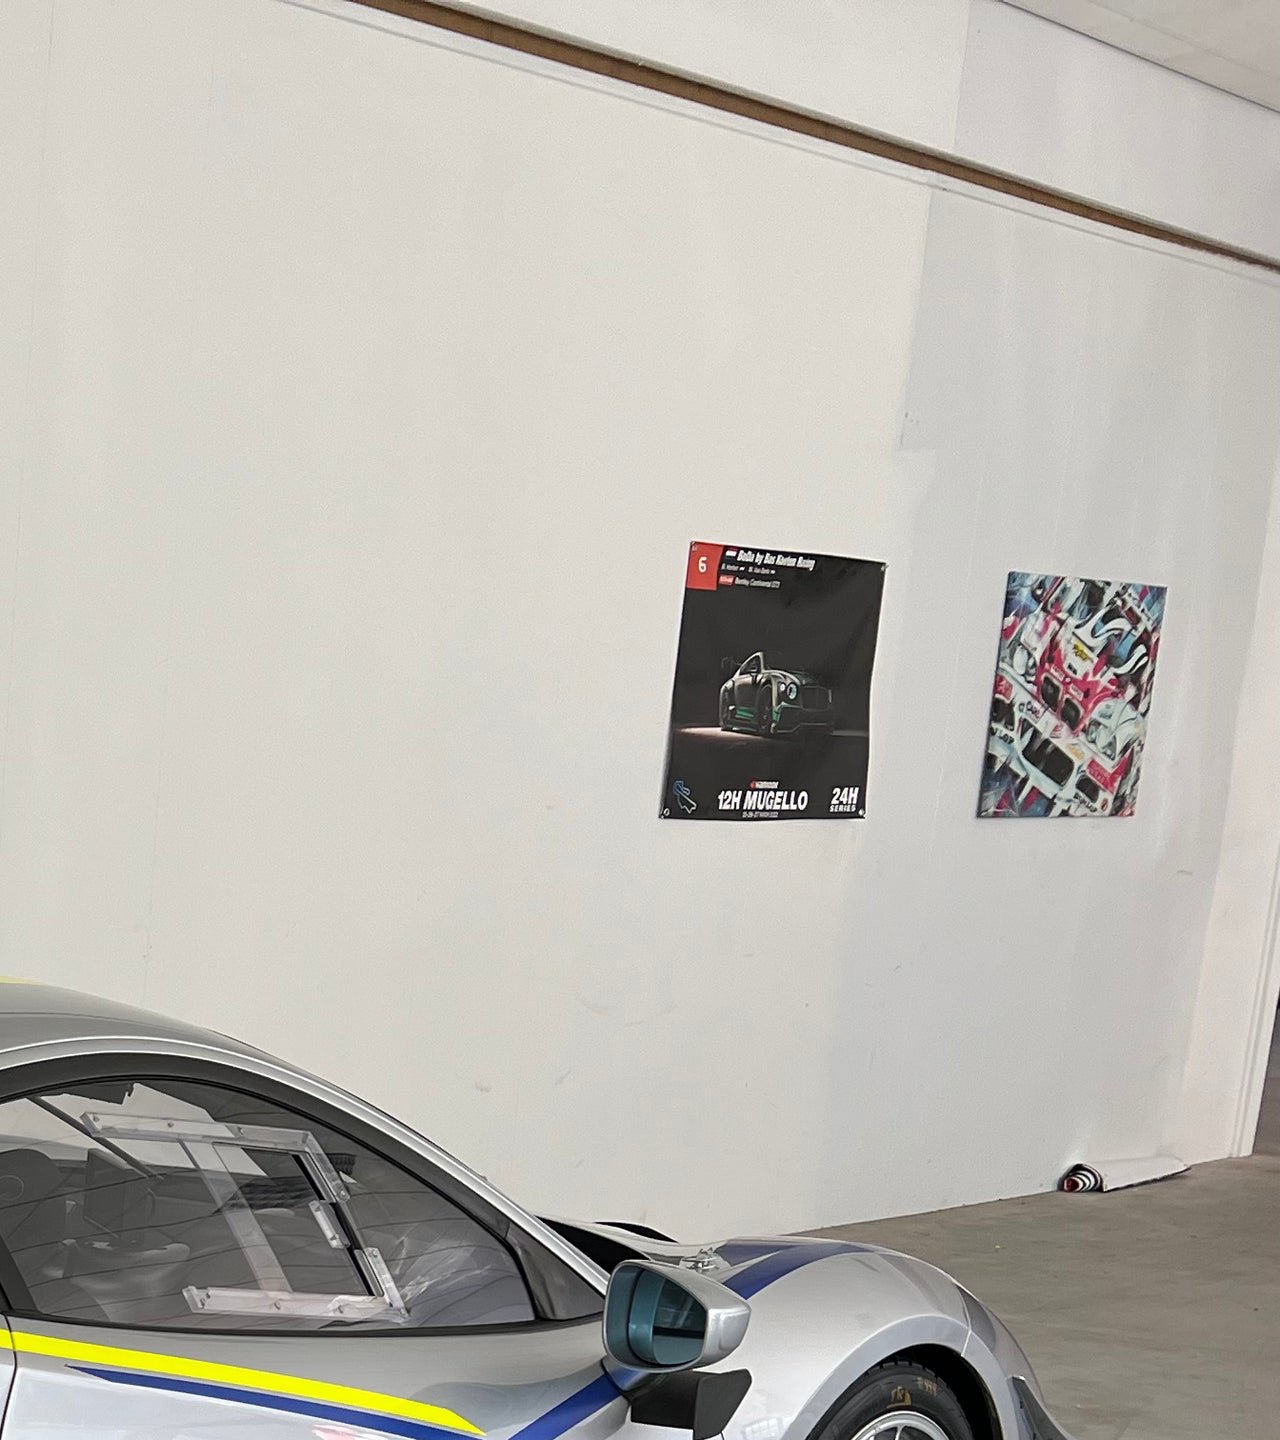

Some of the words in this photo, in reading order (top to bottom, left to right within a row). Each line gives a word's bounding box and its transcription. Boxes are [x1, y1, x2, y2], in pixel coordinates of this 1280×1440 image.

[698, 556, 707, 573] 6
[717, 790, 742, 811] 12H
[742, 790, 809, 811] MUGELLO
[831, 787, 860, 805] 24H
[829, 804, 857, 813] SERIES
